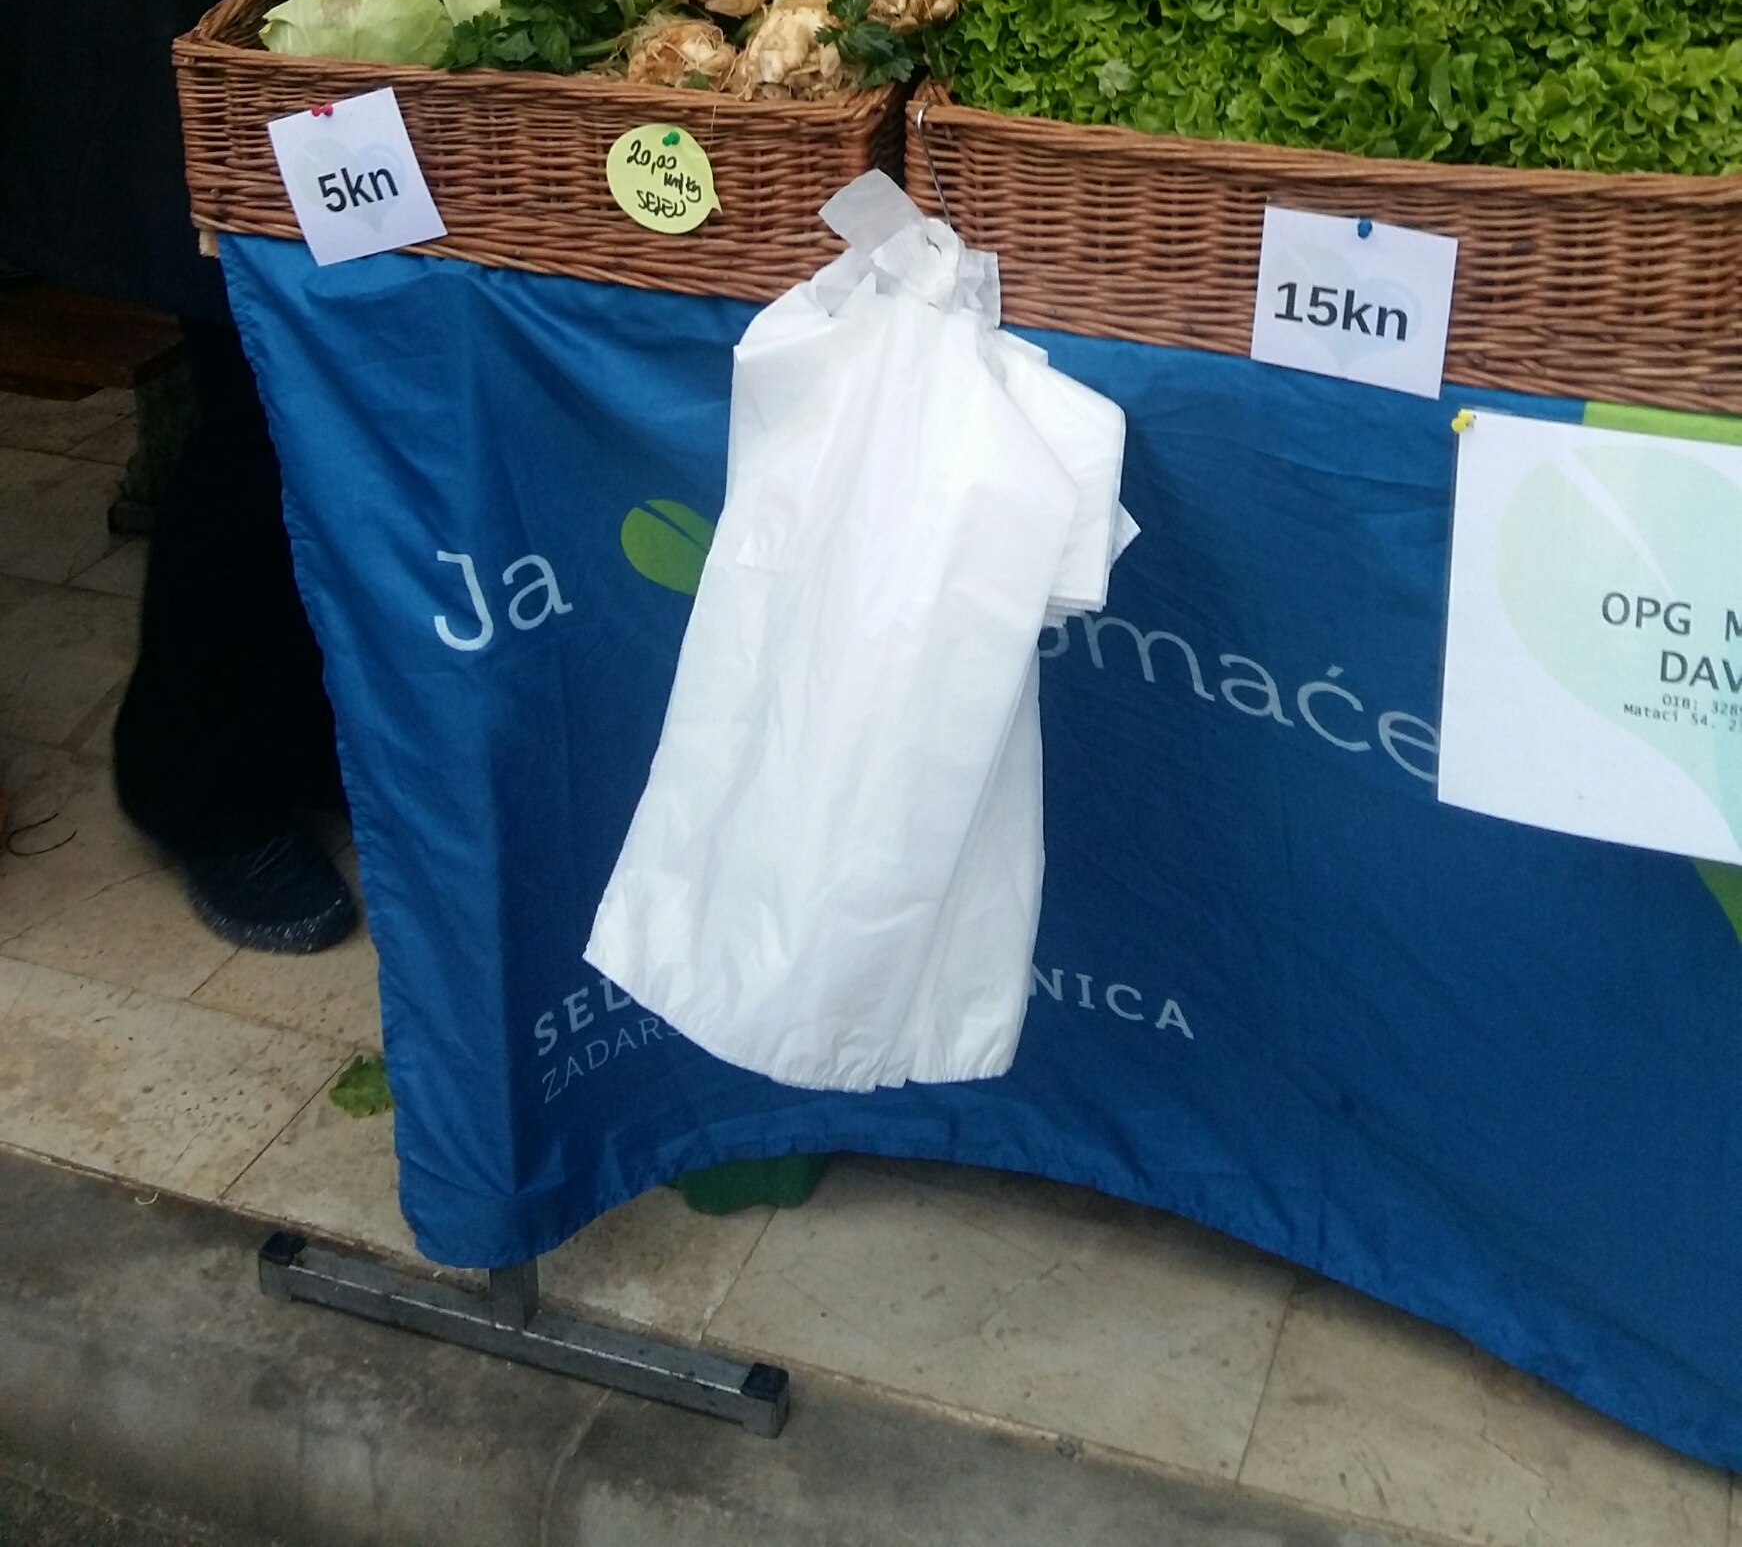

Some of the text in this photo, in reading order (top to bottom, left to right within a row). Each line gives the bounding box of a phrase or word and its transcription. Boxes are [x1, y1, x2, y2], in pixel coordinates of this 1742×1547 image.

[626, 139, 677, 174] 20,00
[317, 167, 399, 212] 5kn
[1274, 281, 1407, 342] 15kn
[434, 550, 574, 651] Ja
[1602, 591, 1691, 636] OPG
